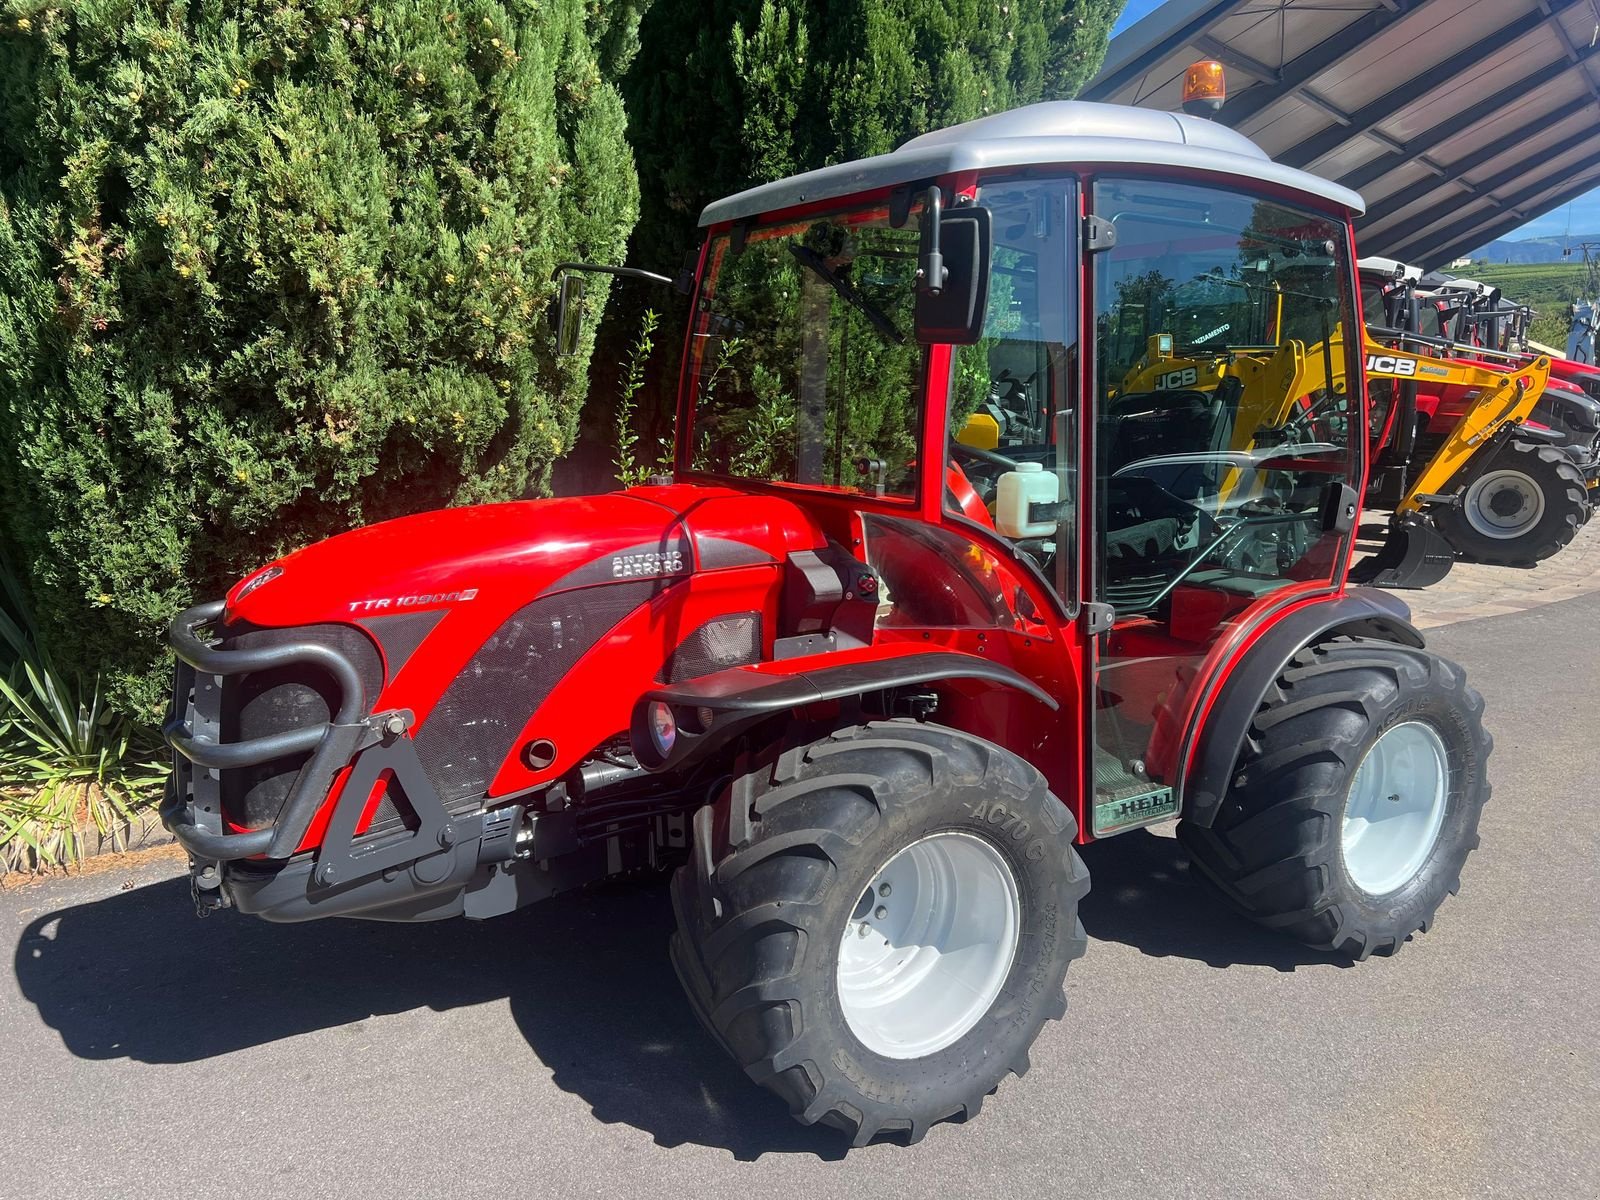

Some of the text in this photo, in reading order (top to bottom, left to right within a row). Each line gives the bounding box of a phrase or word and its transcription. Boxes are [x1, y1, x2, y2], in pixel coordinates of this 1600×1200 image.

[1192, 323, 1230, 344] NZIAMENTO
[1365, 355, 1416, 376] JCB
[1155, 367, 1197, 391] JCB
[612, 551, 682, 566] ANTONIO
[613, 559, 683, 577] CARRARO
[349, 598, 392, 611] TTR
[396, 591, 460, 607] 10900
[969, 800, 1031, 840] AC70
